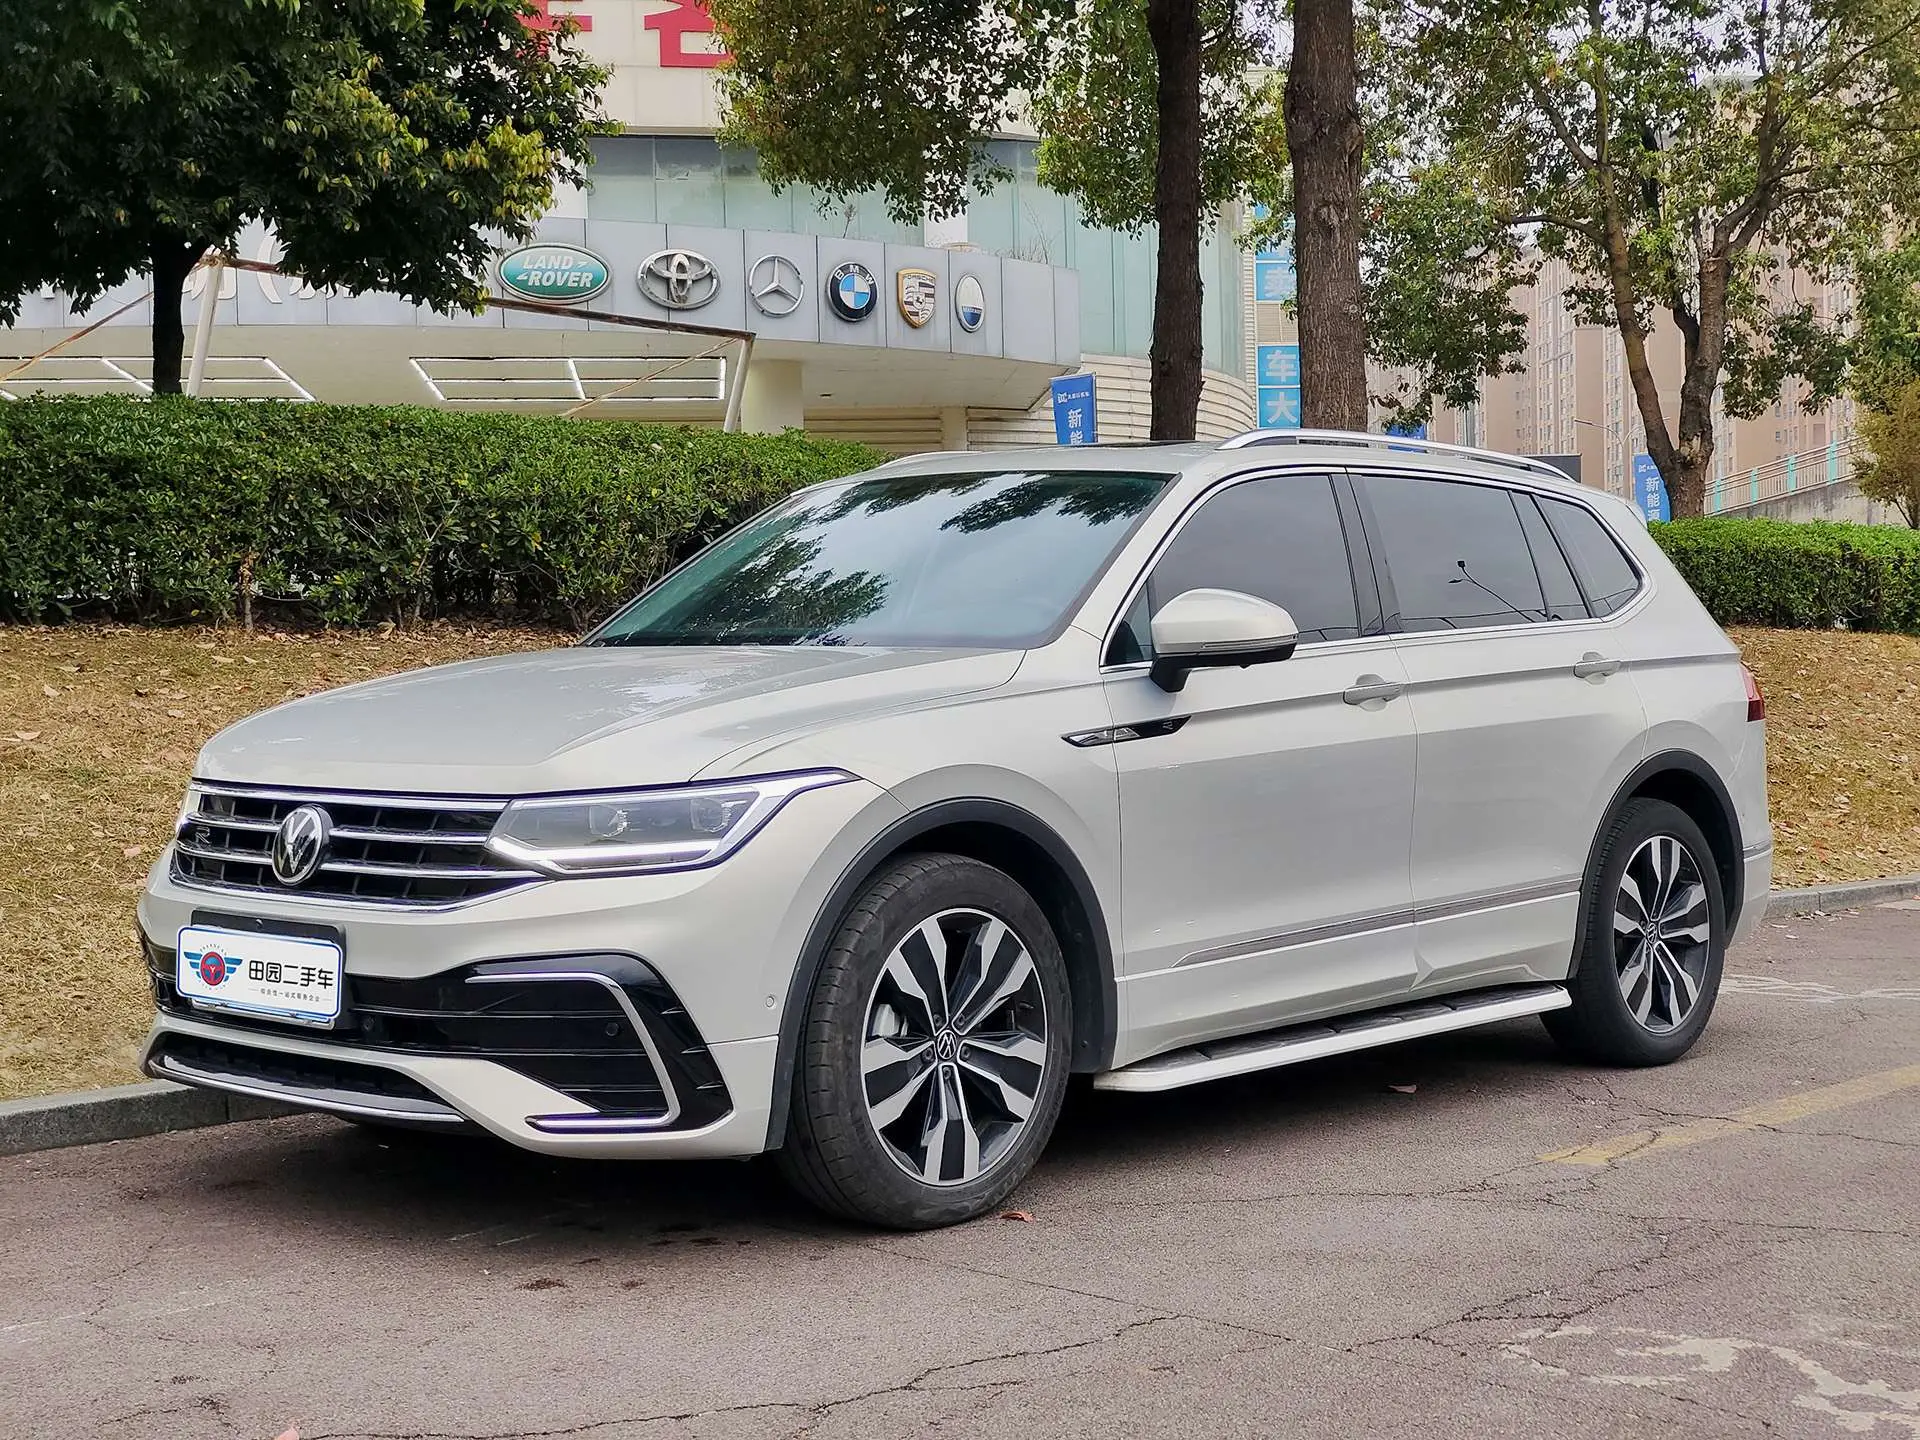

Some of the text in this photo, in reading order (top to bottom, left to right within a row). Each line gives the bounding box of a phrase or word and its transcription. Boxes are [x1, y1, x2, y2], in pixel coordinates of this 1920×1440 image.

[523, 255, 574, 270] LAND
[528, 271, 594, 287] ROVER
[834, 265, 875, 286] BMW
[249, 960, 334, 989] 田园二手车
